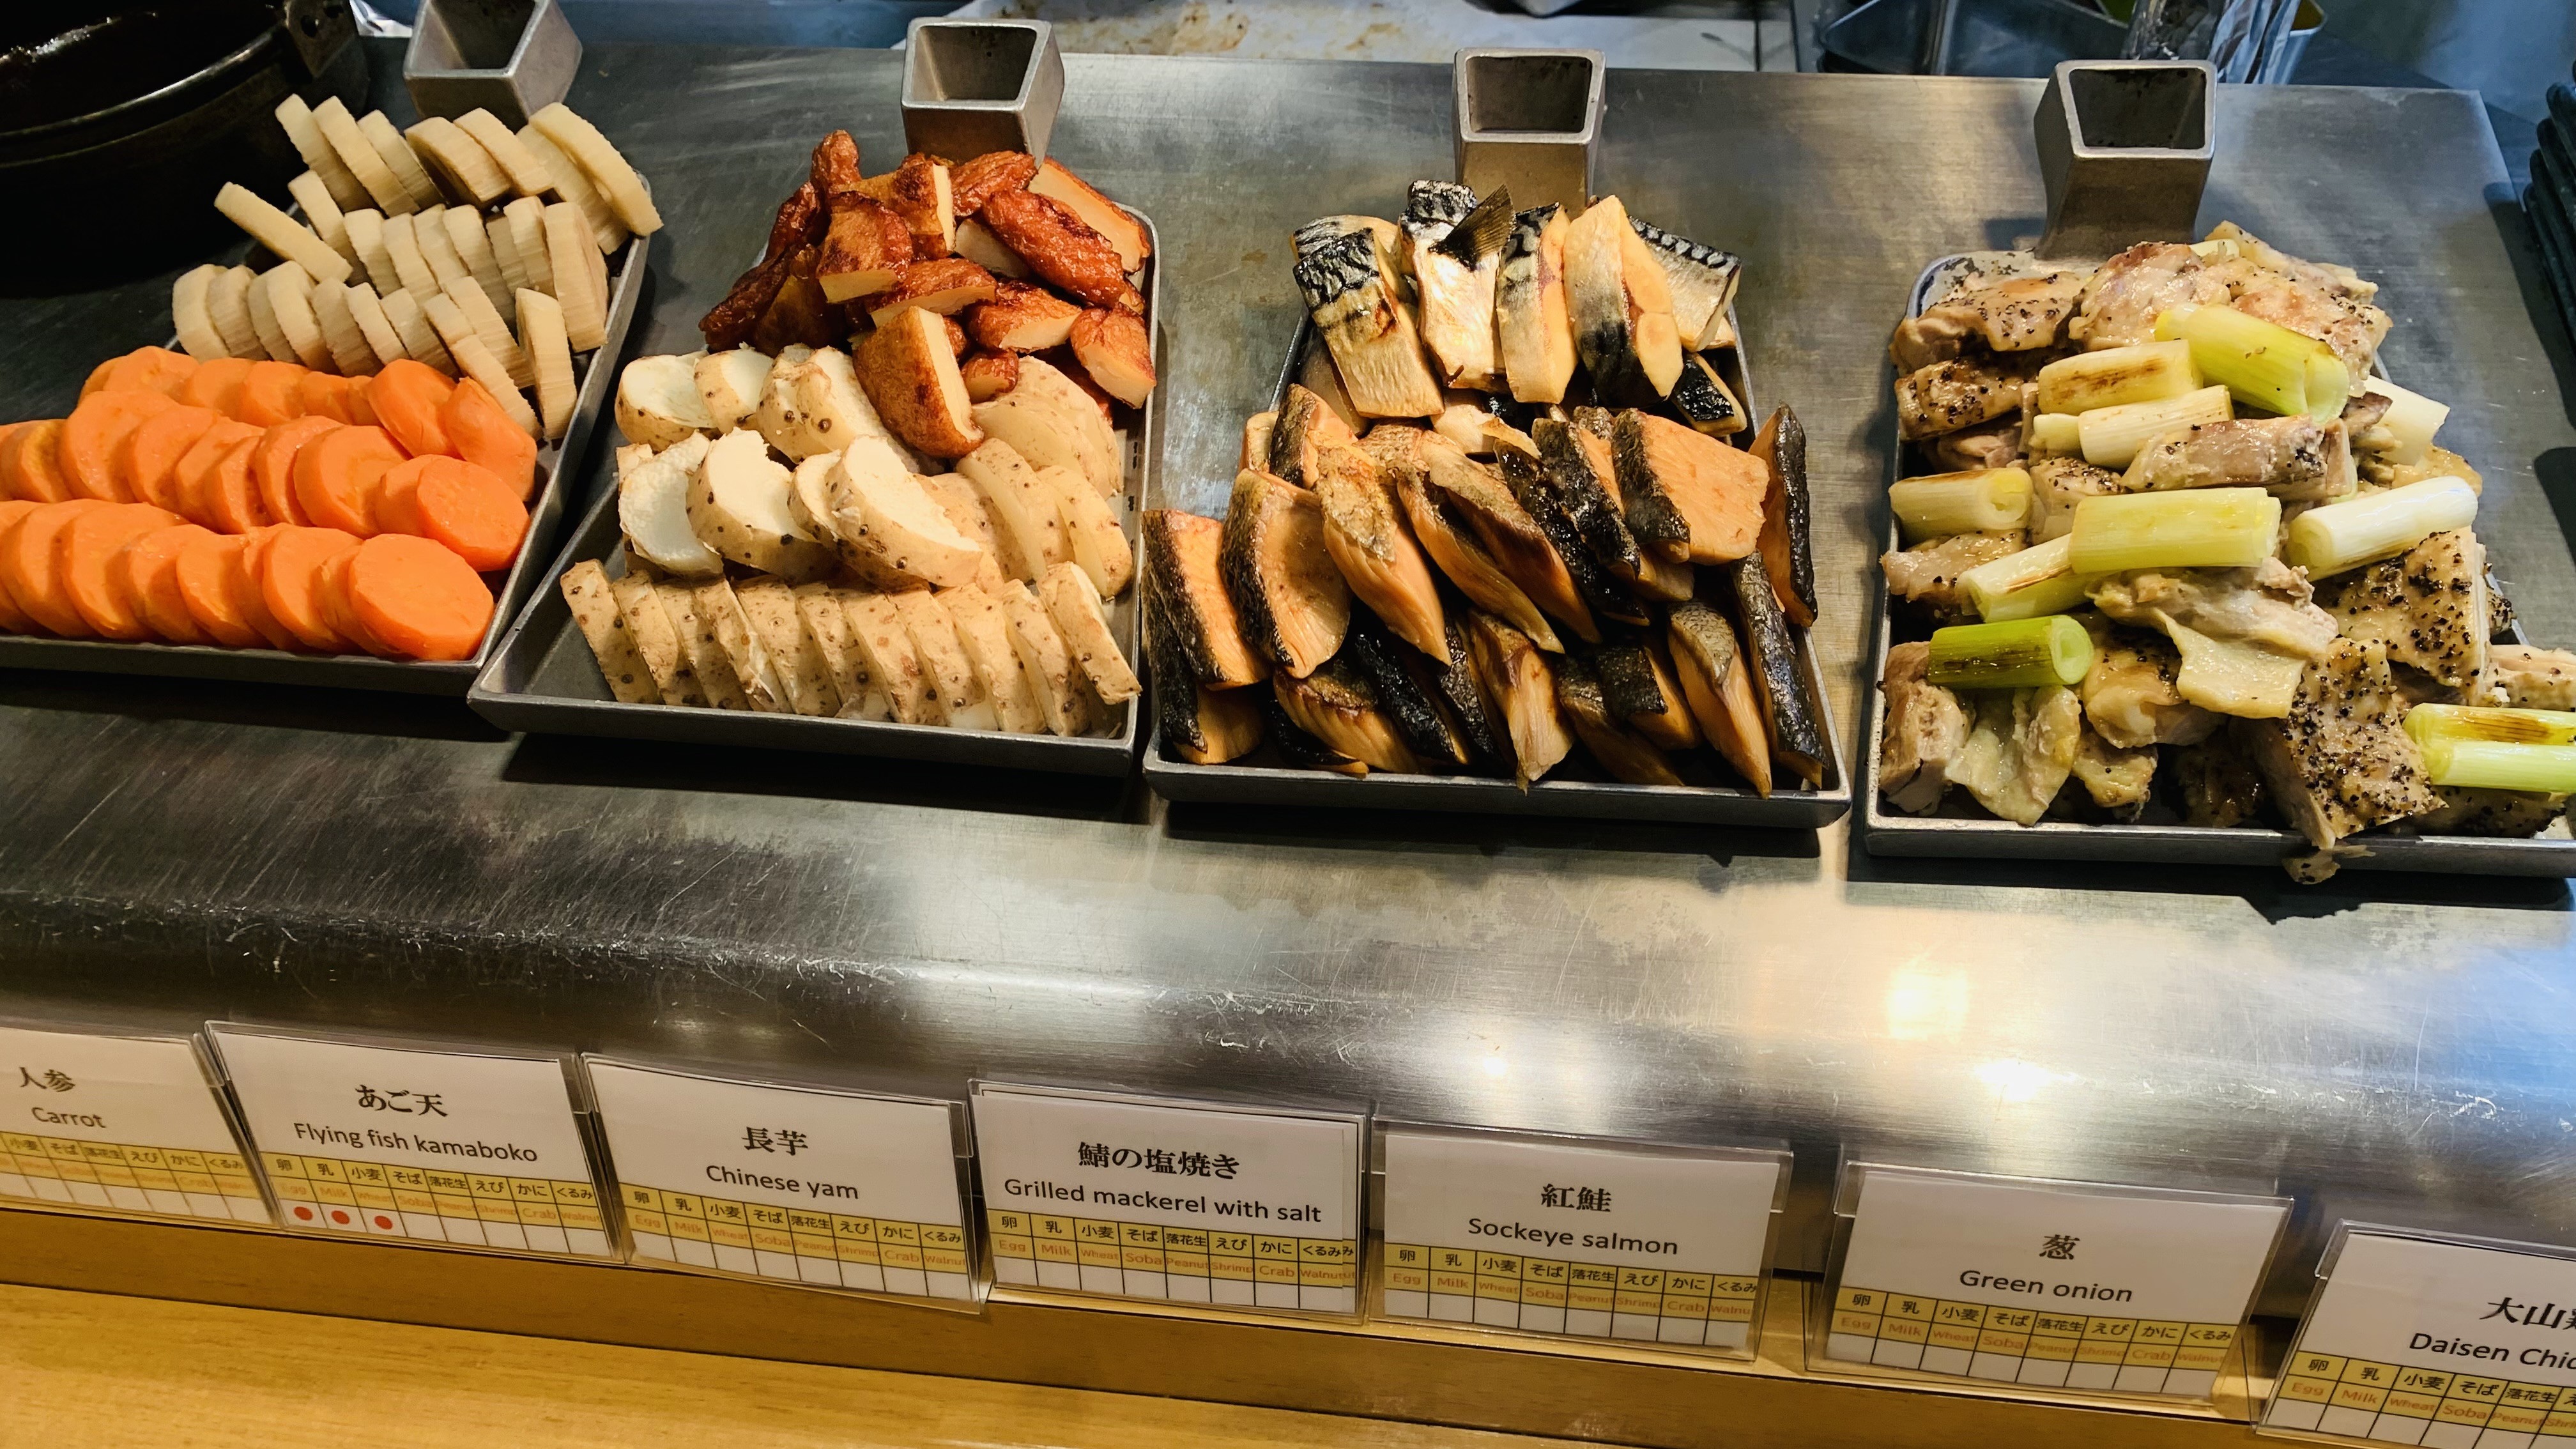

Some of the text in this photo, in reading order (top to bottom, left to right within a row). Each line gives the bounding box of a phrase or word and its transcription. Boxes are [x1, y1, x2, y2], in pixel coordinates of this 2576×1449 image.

[19, 1067, 75, 1092] 人参
[31, 1107, 106, 1128] Carrot
[355, 1084, 448, 1117] あご天
[294, 1123, 537, 1162] Flying fish kamaboko
[741, 1126, 809, 1156] 長芋
[1078, 1142, 1239, 1179] 鯖の塩焼き
[351, 1167, 382, 1181] 小麦
[393, 1171, 422, 1184] そば
[475, 1180, 504, 1193] えび
[517, 1183, 548, 1197] かに
[556, 1187, 592, 1199] くるみ
[706, 1165, 859, 1199] Chinese yam
[1004, 1178, 1322, 1223] Grilled mackerel with salt
[1541, 1183, 1611, 1212] 紅鮭
[675, 1198, 692, 1211] 乳
[710, 1204, 742, 1219] 小麦
[753, 1209, 784, 1223] そば
[791, 1215, 831, 1229] 落花生
[839, 1220, 870, 1234] えび
[882, 1226, 914, 1239] かに
[924, 1231, 961, 1243] くるみ
[1002, 1216, 1017, 1229] 卵
[1045, 1221, 1062, 1234] 乳
[1082, 1224, 1114, 1239] 小麦
[1126, 1229, 1158, 1242] そば
[1165, 1232, 1207, 1246] 落花生
[1216, 1237, 1247, 1250] えび
[1261, 1241, 1292, 1254] かに
[1468, 1218, 1678, 1255] Sockeye salmon
[884, 1250, 919, 1262] Crab
[999, 1239, 1026, 1252] Egg
[1041, 1244, 1071, 1256] Milk
[1081, 1248, 1118, 1261] Wheat
[1125, 1252, 1162, 1265] Soba
[1259, 1265, 1295, 1277] Crab
[2039, 1234, 2080, 1260] 葱
[1400, 1249, 1415, 1262] 卵
[1445, 1254, 1462, 1266] 乳
[1483, 1257, 1517, 1273] 小麦
[1530, 1264, 1563, 1278] そば
[1572, 1268, 1614, 1283] 落花生
[1624, 1273, 1658, 1286] えび
[1671, 1277, 1705, 1291] かに
[1959, 1269, 2133, 1303] Green onion
[1393, 1273, 1421, 1285] Egg
[1438, 1277, 1469, 1289] Milk
[1525, 1287, 1564, 1301] Soba
[1667, 1301, 1705, 1313] Crab
[1852, 1294, 2232, 1341] 卵 乳 小麦 そば 落花生 えび かに くるみ
[1888, 1322, 1921, 1337] Milk
[1982, 1335, 2023, 1349] Soba
[2132, 1349, 2170, 1361] Crab
[2409, 1333, 2510, 1361] Daisen
[2308, 1359, 2329, 1372] 卵
[2361, 1367, 2379, 1381] 乳
[2404, 1374, 2445, 1390] 小麦
[2460, 1381, 2499, 1396] そば
[2505, 1388, 2556, 1403] 落花生
[2292, 1382, 2324, 1396] Egg
[2342, 1390, 2378, 1404] Milk
[2391, 1397, 2434, 1412] Wheat
[2443, 1404, 2487, 1420] Soba
